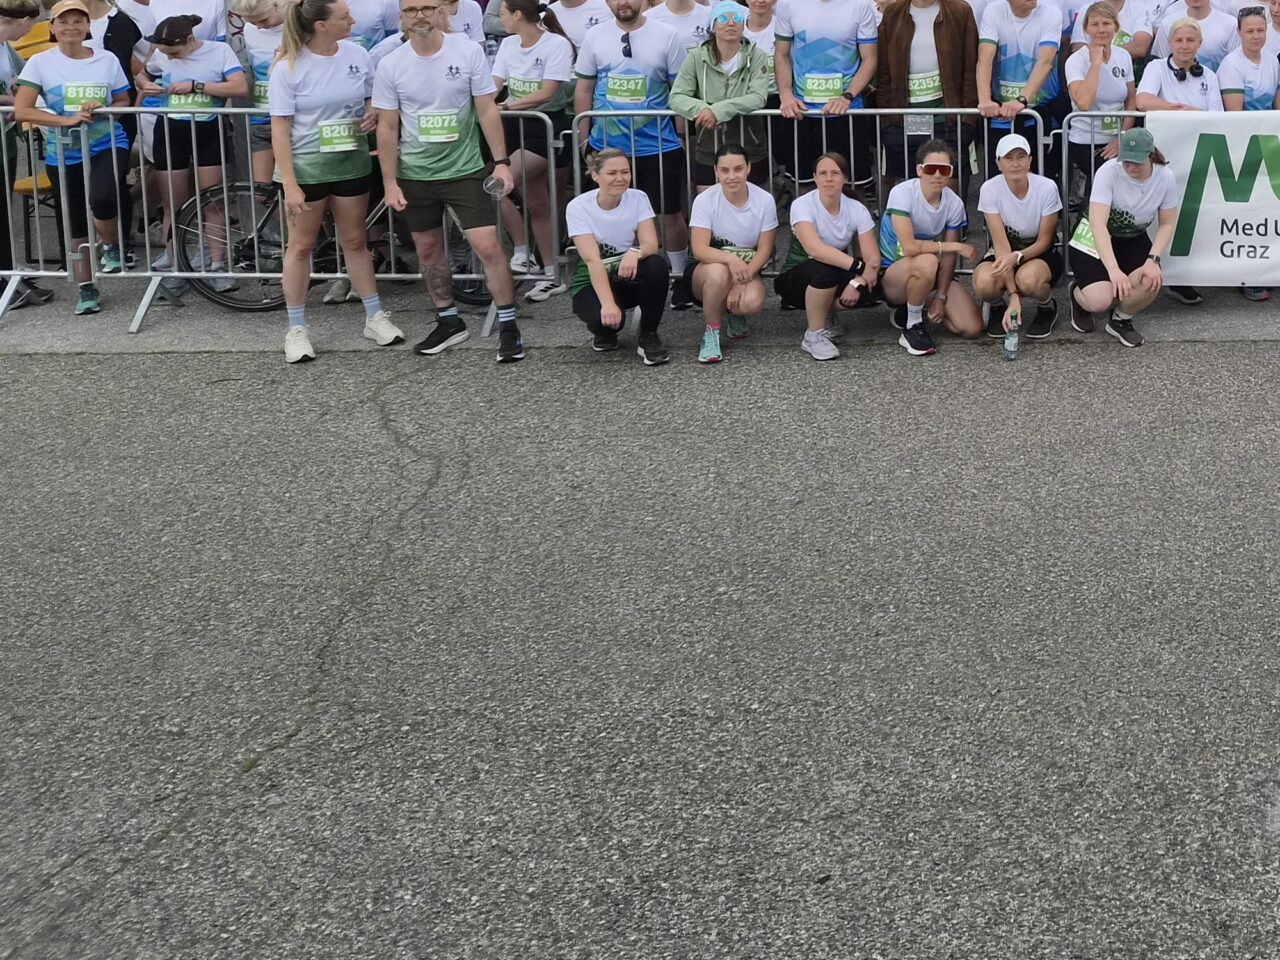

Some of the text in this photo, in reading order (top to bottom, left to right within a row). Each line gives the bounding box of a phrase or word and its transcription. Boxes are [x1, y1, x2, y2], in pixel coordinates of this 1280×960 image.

[608, 78, 643, 91] 82347
[807, 78, 841, 90] 82349
[67, 85, 107, 99] 81850
[419, 114, 458, 128] 82072
[1219, 217, 1269, 237] Med
[1219, 239, 1271, 260] Graz
